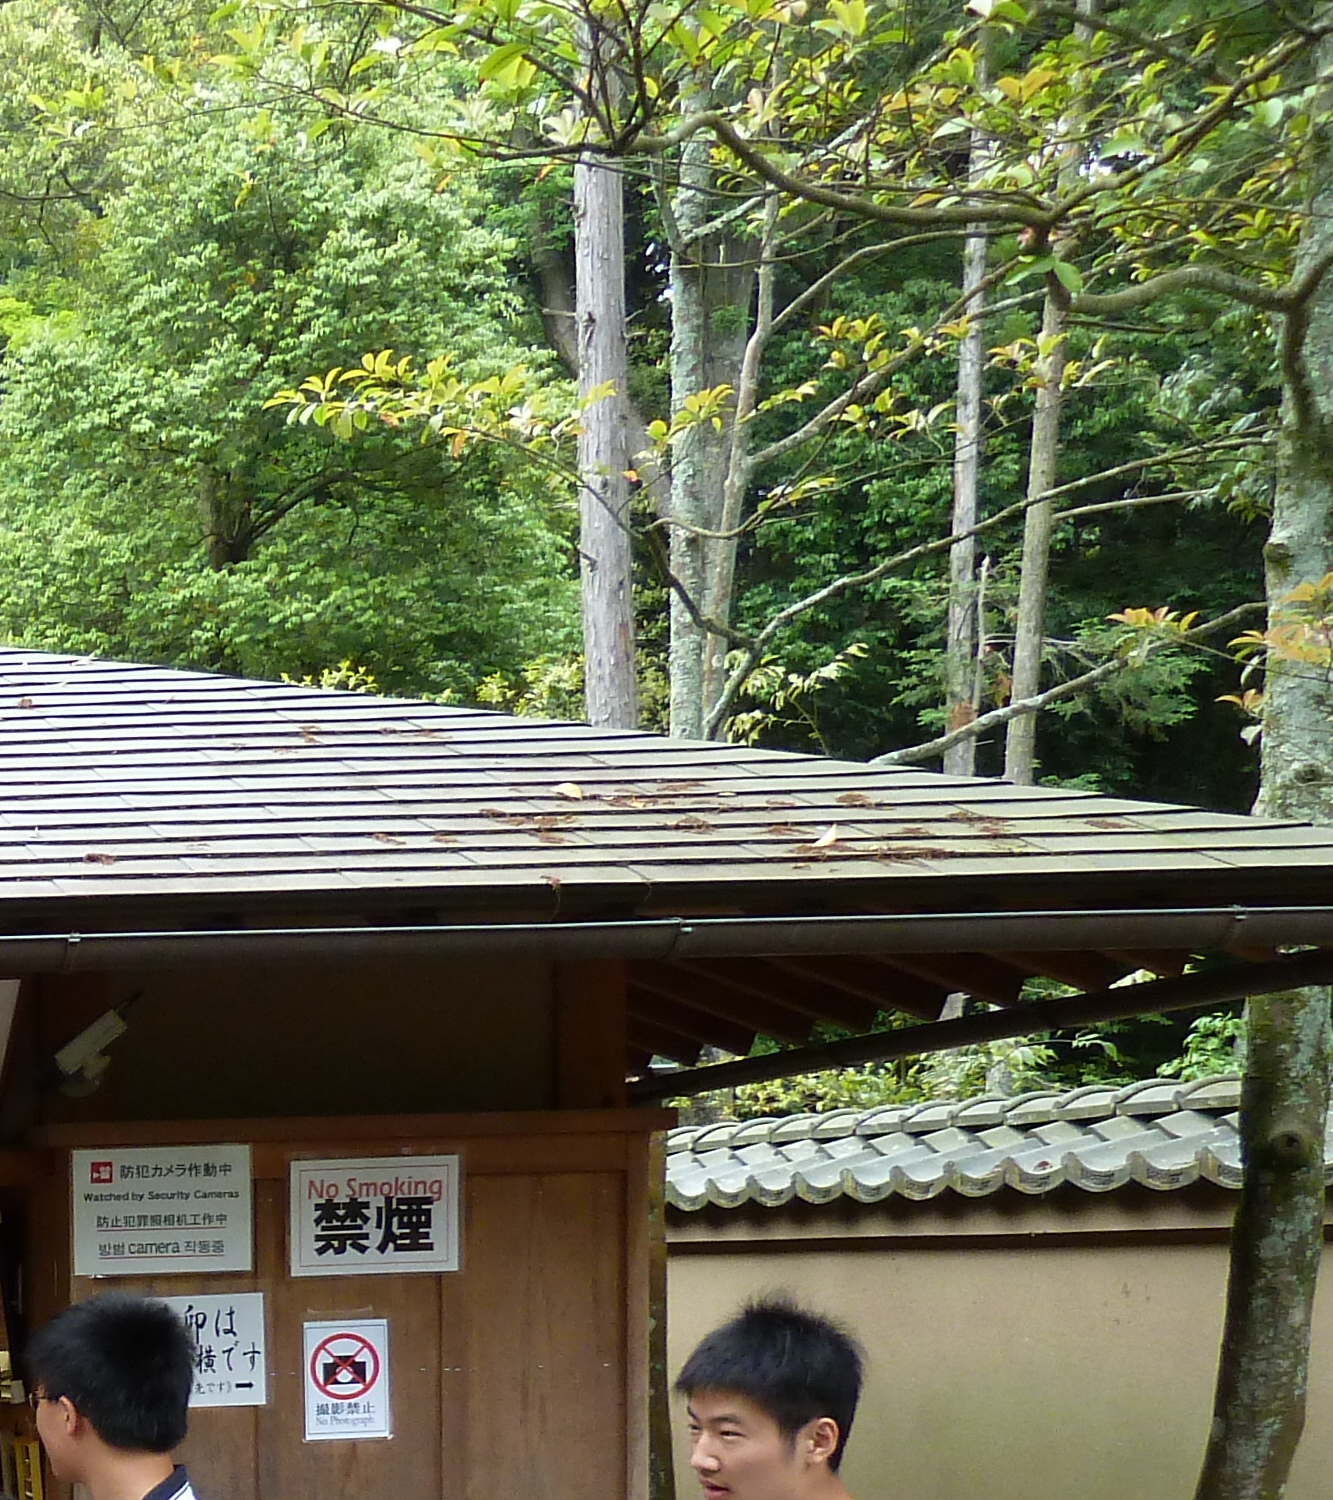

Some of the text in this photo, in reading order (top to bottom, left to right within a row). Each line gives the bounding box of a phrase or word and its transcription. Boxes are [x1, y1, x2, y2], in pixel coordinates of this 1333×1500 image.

[119, 1162, 233, 1180] 防犯カメラ作動中
[83, 1188, 240, 1203] Watched by Security Cameras
[308, 1176, 444, 1203] No Smoking
[96, 1212, 228, 1229] 防止犯罪照相机工作中
[313, 1196, 435, 1257] 禁煙
[128, 1240, 180, 1254] camera
[316, 1401, 376, 1416] 撮影禁止
[315, 1416, 329, 1426] No
